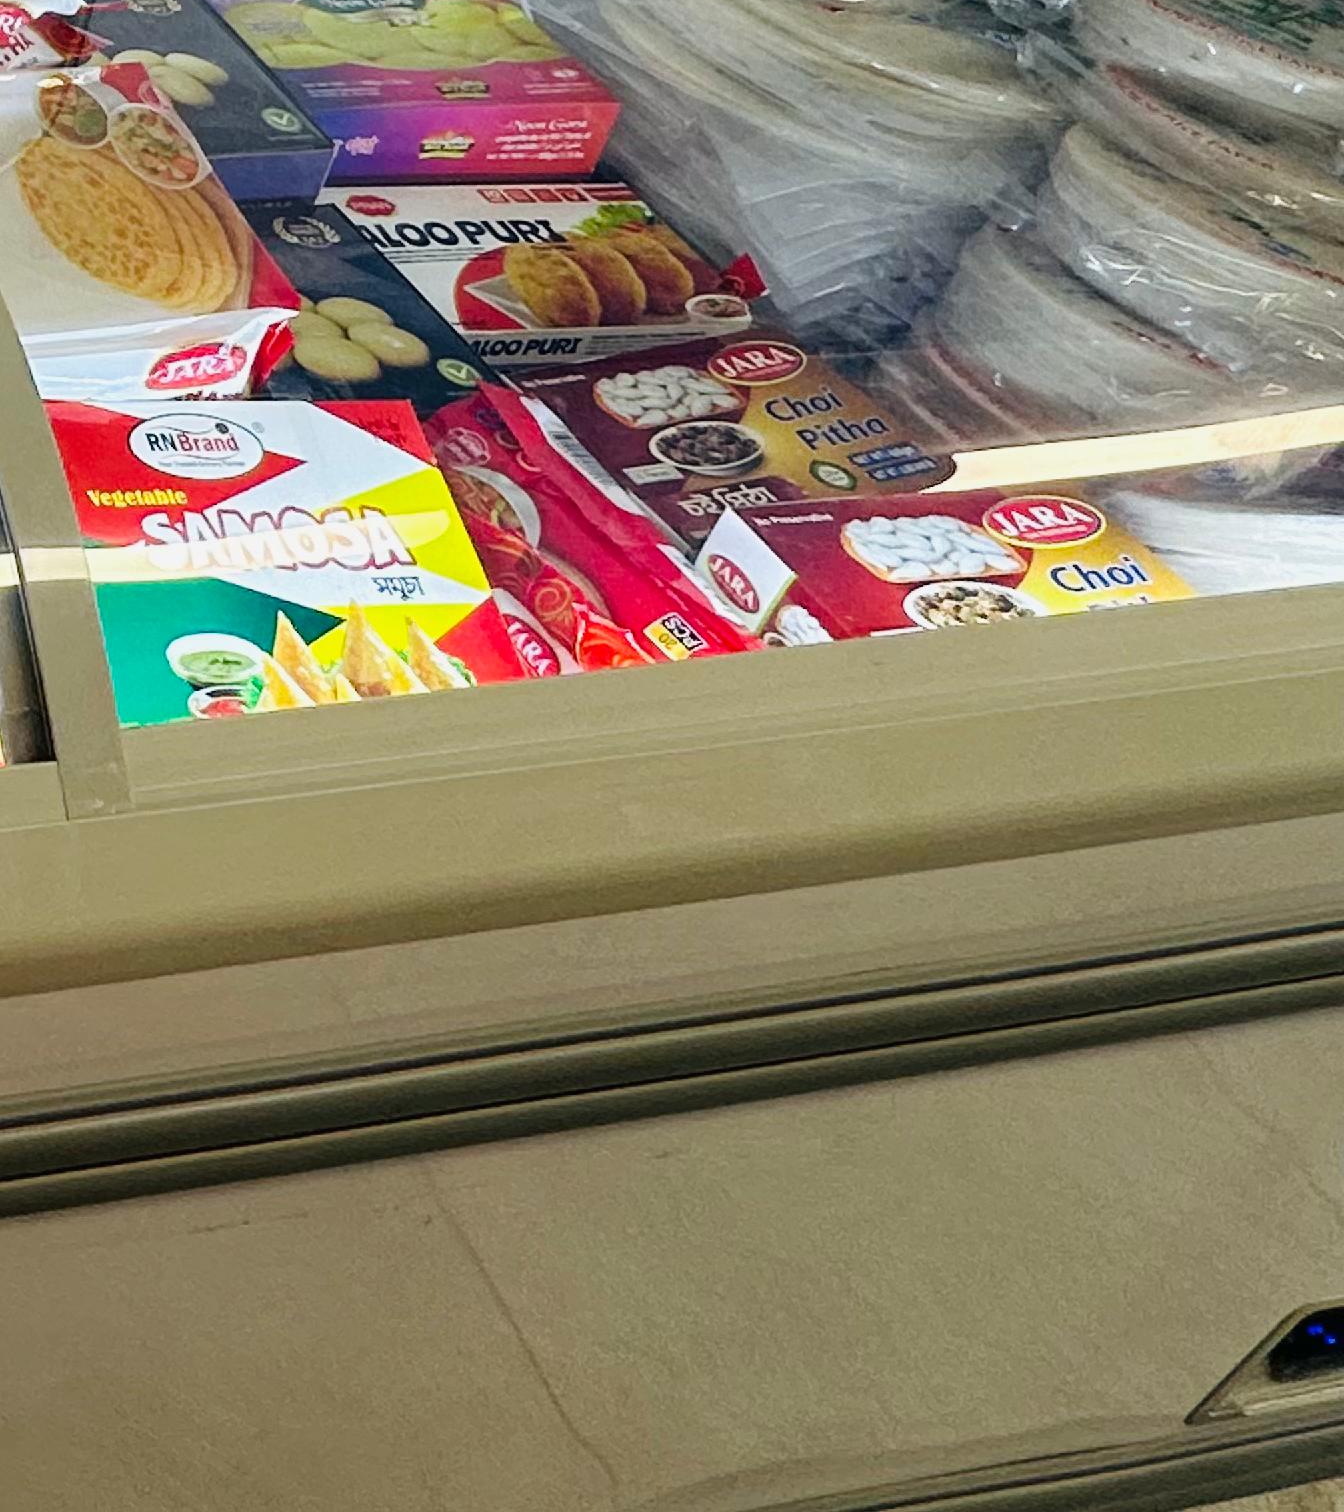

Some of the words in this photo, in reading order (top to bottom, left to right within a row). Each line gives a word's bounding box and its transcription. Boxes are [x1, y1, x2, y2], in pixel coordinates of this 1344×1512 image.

[361, 223, 459, 248] ALOO
[464, 218, 567, 246] PURI
[520, 336, 582, 358] PURI
[716, 346, 798, 378] JARA
[155, 354, 235, 384] JARA
[765, 387, 845, 422] Choi
[796, 415, 892, 451] Pitha
[87, 488, 189, 509] Vegetable
[141, 506, 418, 571] SAMOSA
[991, 502, 1092, 540] JARA
[712, 553, 759, 609] JARA
[1049, 556, 1150, 596] Choi
